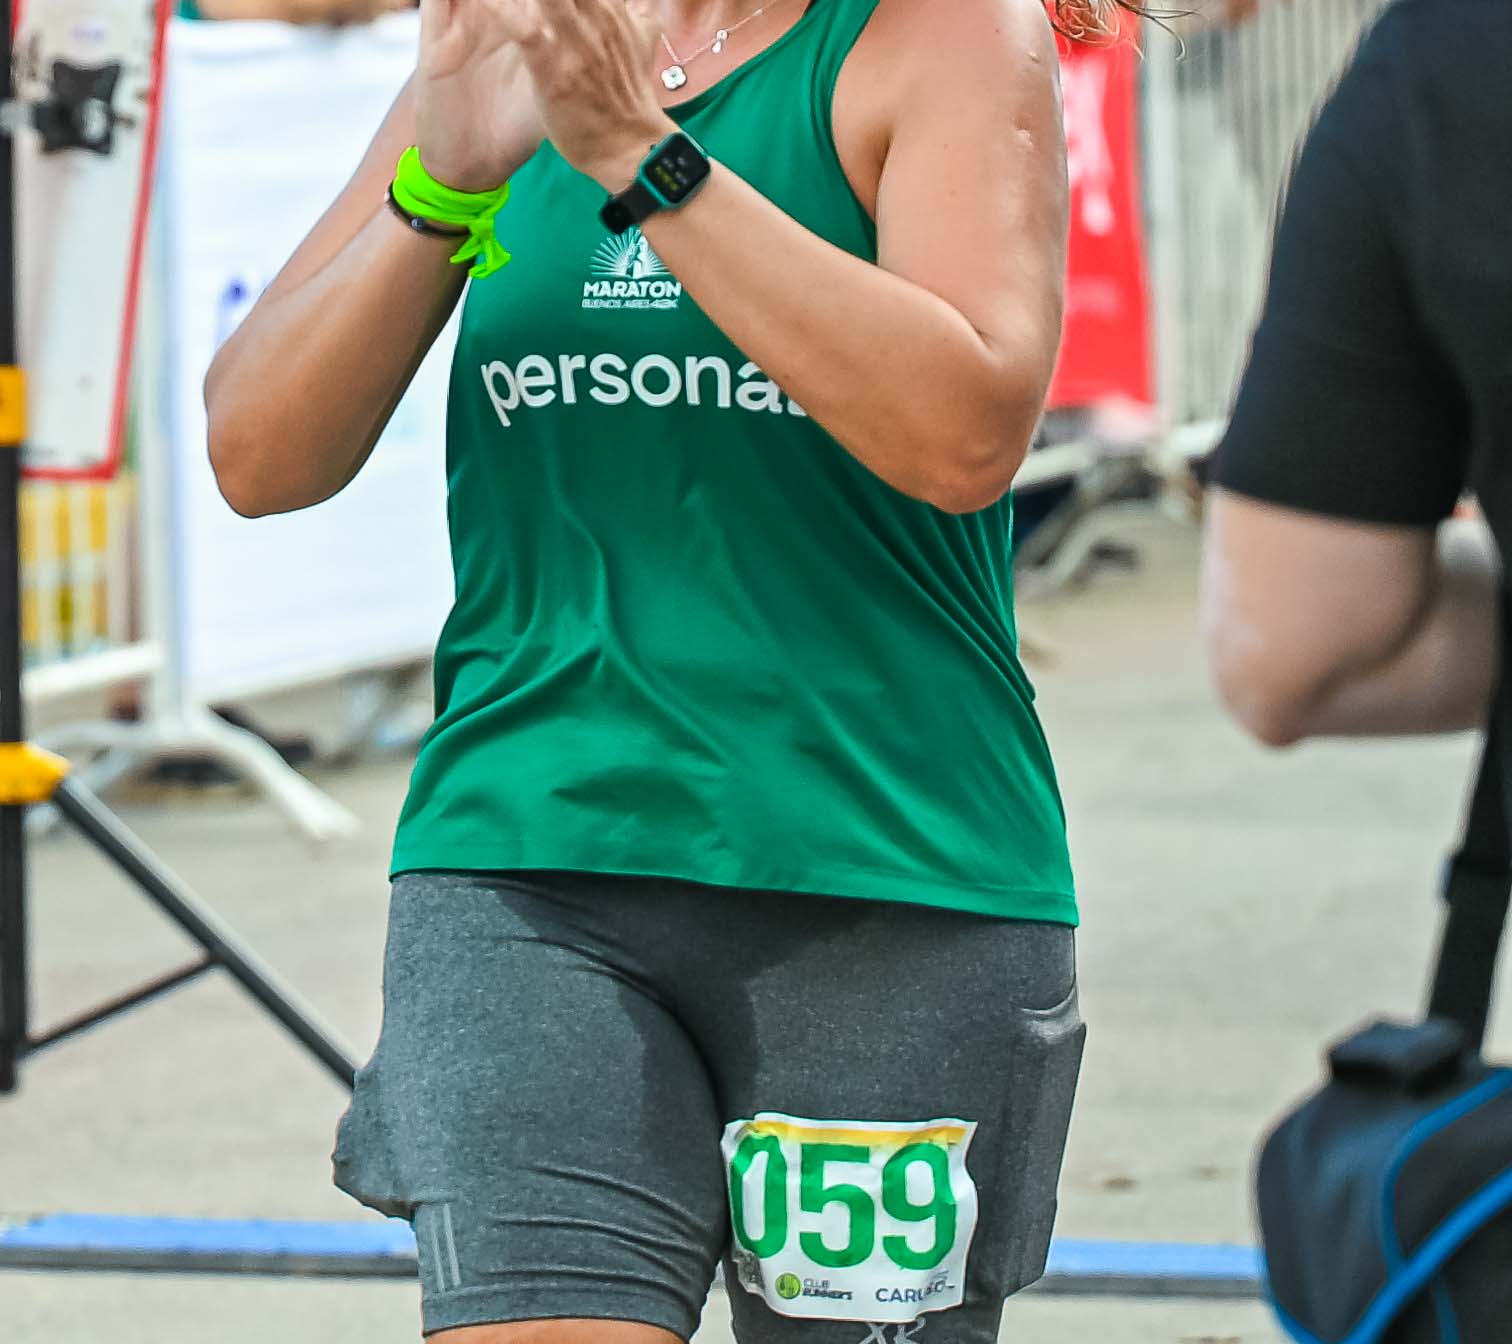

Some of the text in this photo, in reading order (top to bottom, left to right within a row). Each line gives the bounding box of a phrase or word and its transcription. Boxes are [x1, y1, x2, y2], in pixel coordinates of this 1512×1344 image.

[583, 280, 682, 298] MARATON
[479, 352, 809, 427] persona
[729, 1135, 957, 1270] 059
